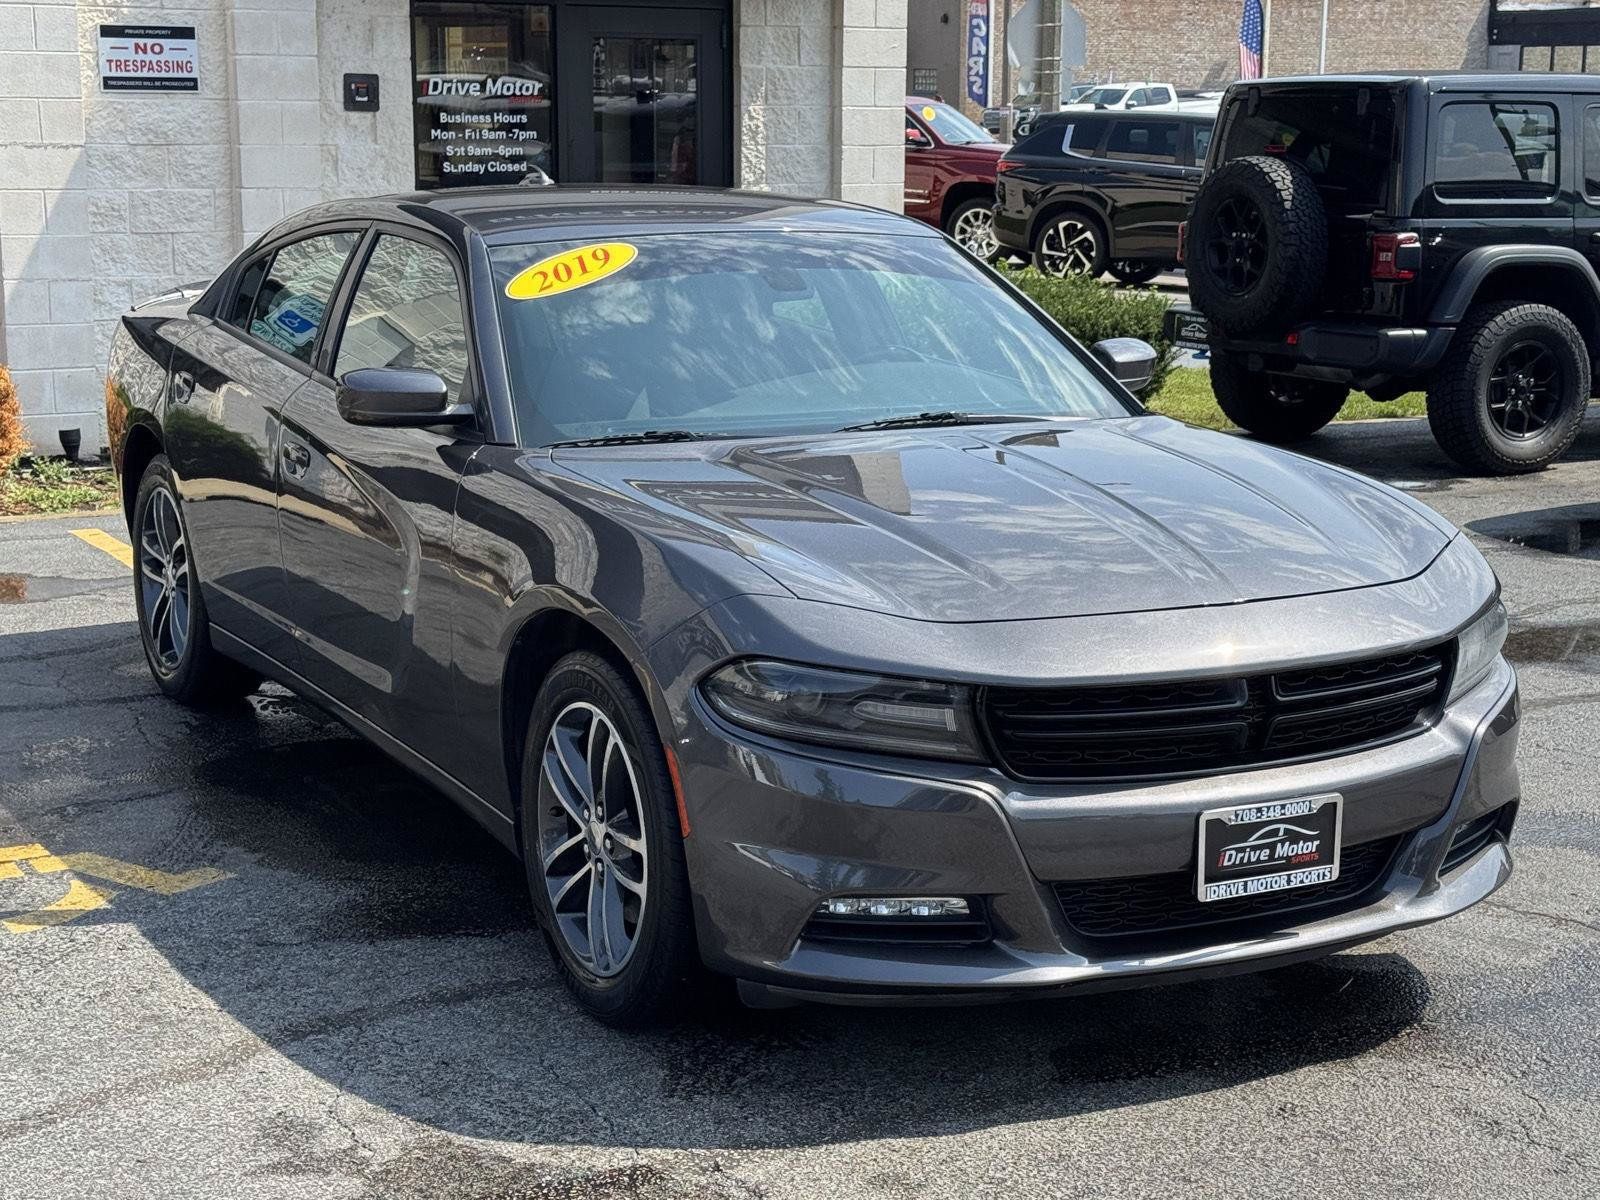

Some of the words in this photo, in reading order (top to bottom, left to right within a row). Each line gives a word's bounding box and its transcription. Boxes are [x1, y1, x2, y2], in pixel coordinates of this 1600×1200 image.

[135, 43, 164, 55] NO
[107, 60, 193, 73] TRESPASSING
[486, 79, 542, 95] Motor
[440, 112, 491, 122] Business
[494, 112, 527, 122] Hours
[431, 130, 456, 139] Mon
[482, 130, 506, 139] 9am
[488, 162, 527, 172] Closed
[532, 248, 610, 292] 2019
[1236, 801, 1310, 821] 708-348-0000
[1218, 848, 1270, 867] iDrive
[1275, 840, 1320, 859] Motor
[1291, 853, 1319, 864] SPORTS
[1247, 876, 1288, 893] MOTOR
[1289, 868, 1331, 886] SPORTS
